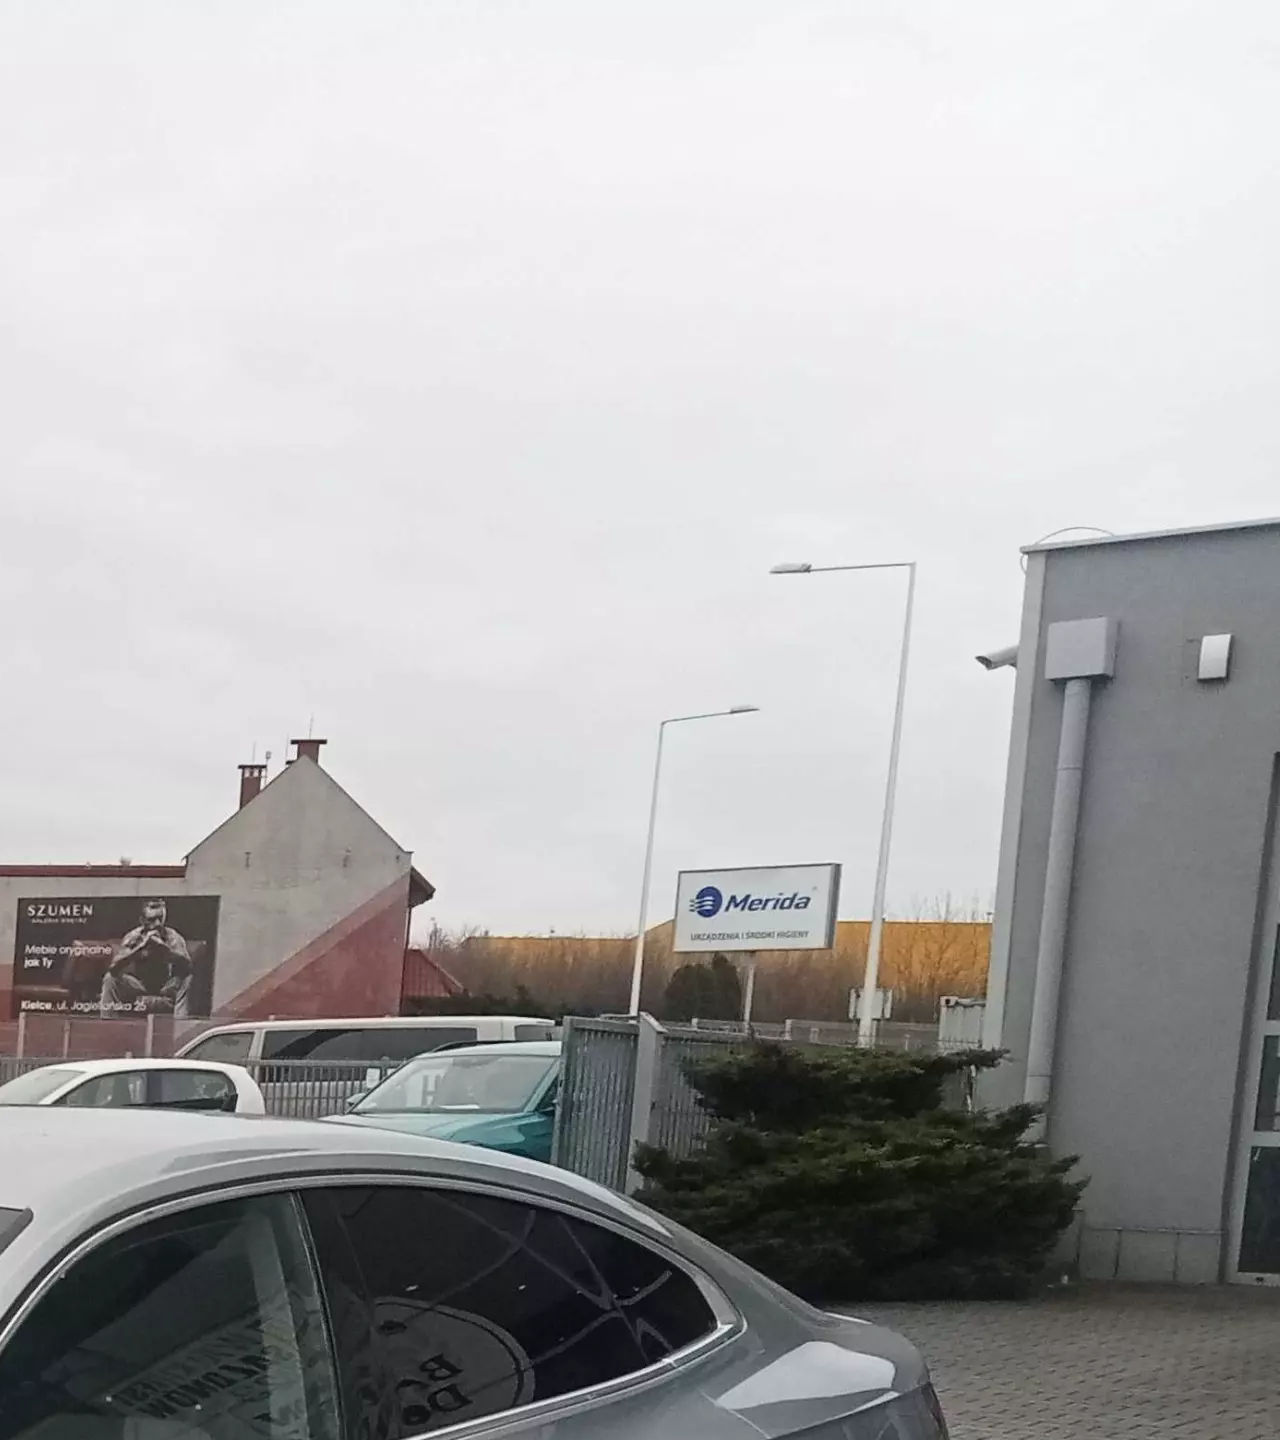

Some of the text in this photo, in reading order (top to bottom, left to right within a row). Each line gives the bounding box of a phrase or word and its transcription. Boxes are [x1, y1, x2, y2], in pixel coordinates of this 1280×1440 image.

[724, 892, 812, 913] Merida
[27, 904, 94, 917] SZUMEN
[24, 944, 58, 955] Meble
[24, 956, 53, 969] jak Ty
